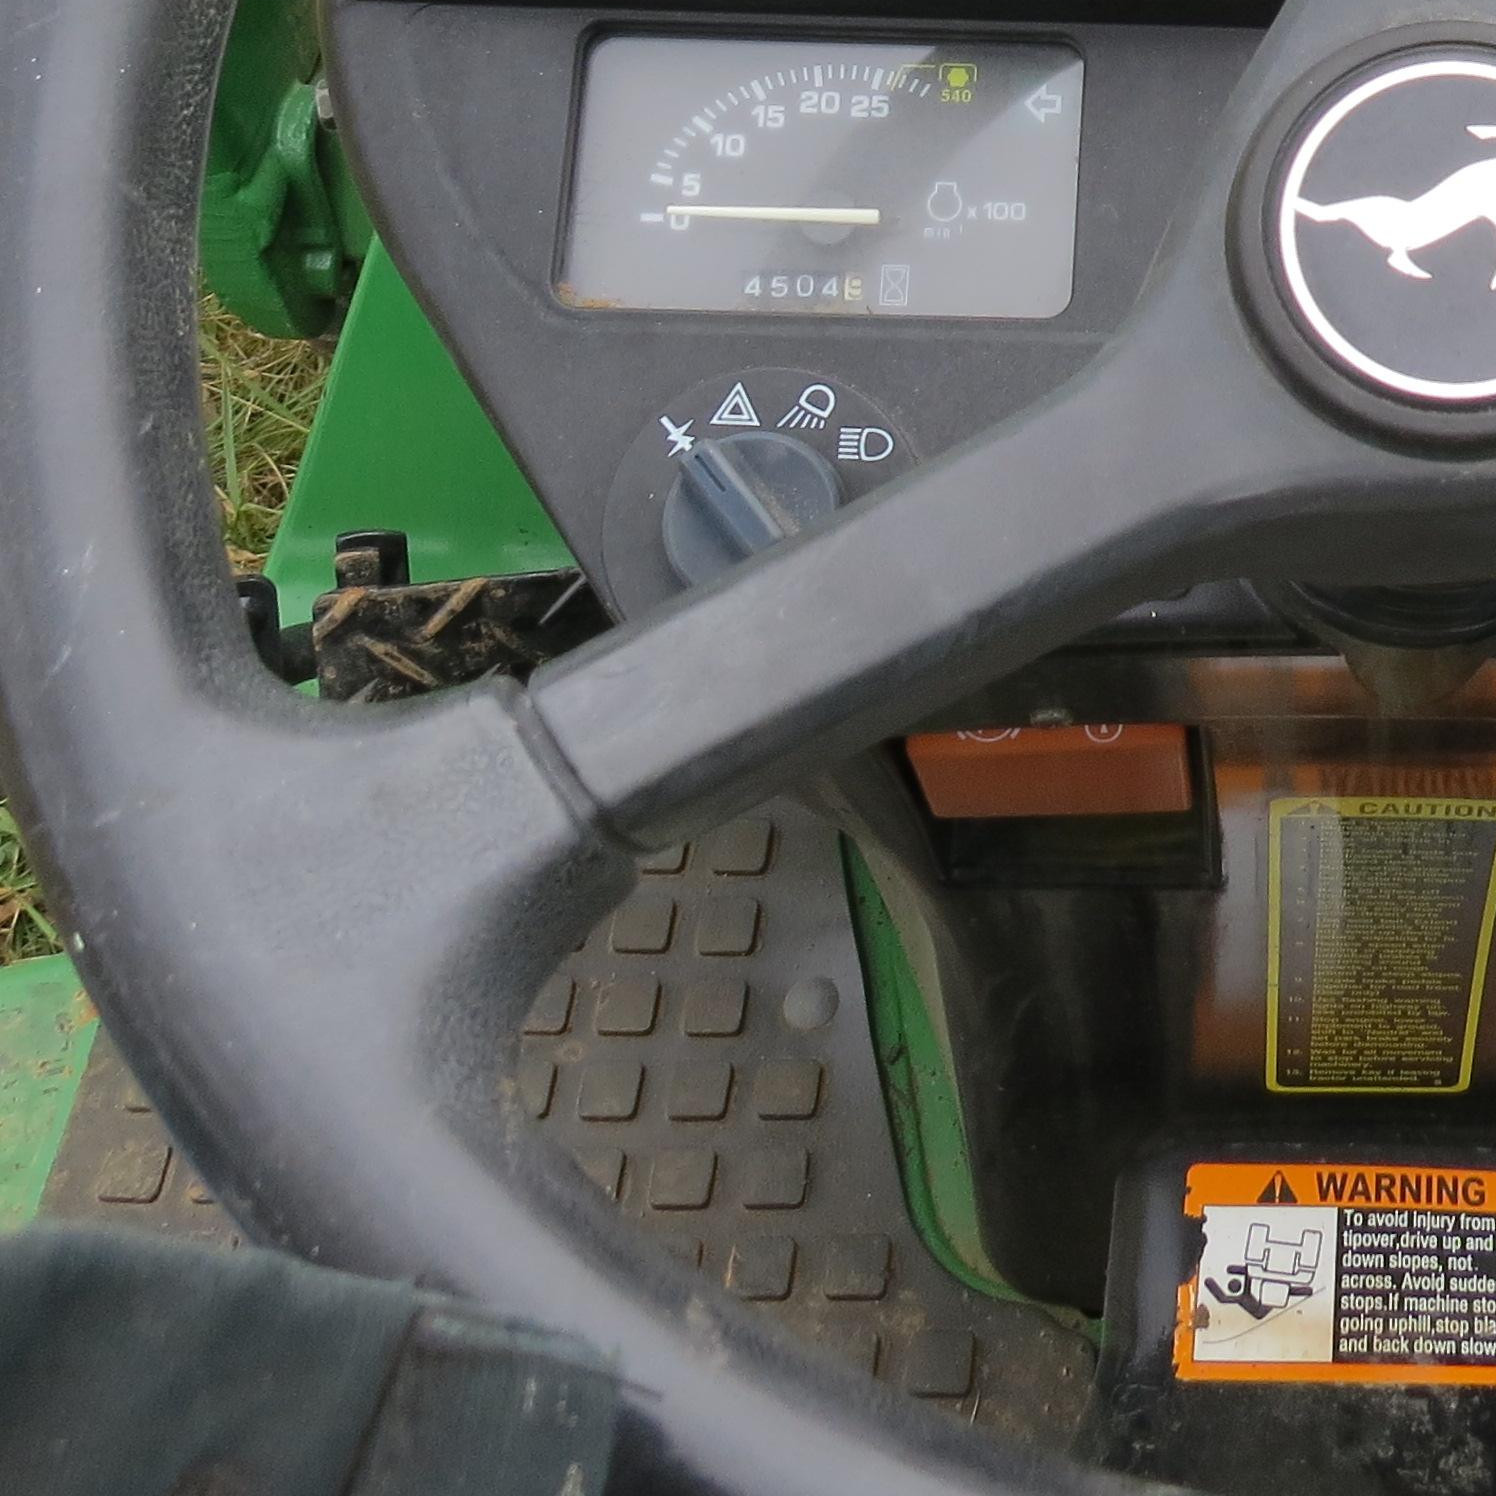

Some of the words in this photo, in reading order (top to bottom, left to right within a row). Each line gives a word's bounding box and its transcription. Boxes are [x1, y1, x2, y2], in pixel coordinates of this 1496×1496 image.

[800, 90, 840, 115] 20
[850, 94, 890, 119] 25
[940, 89, 972, 103] 540
[751, 104, 786, 129] 15
[709, 133, 746, 157] 10
[681, 173, 701, 197] 5
[983, 202, 1026, 221] 100
[1358, 801, 1496, 818] CAUTION
[1316, 1171, 1486, 1207] WARNING
[1343, 1208, 1363, 1226] To
[1367, 1210, 1408, 1228] avoid
[1413, 1210, 1456, 1233] injury
[1460, 1213, 1496, 1231] from
[1442, 1235, 1462, 1253] up
[1465, 1234, 1494, 1252] and
[1342, 1250, 1384, 1268] down
[1389, 1251, 1443, 1272] slopes,
[1341, 1274, 1397, 1290] across.
[1401, 1272, 1445, 1293] Avoid
[1403, 1294, 1468, 1312] machine
[1340, 1314, 1384, 1335] going
[1339, 1335, 1367, 1353] and
[1372, 1335, 1409, 1354] back
[1413, 1337, 1456, 1355] down
